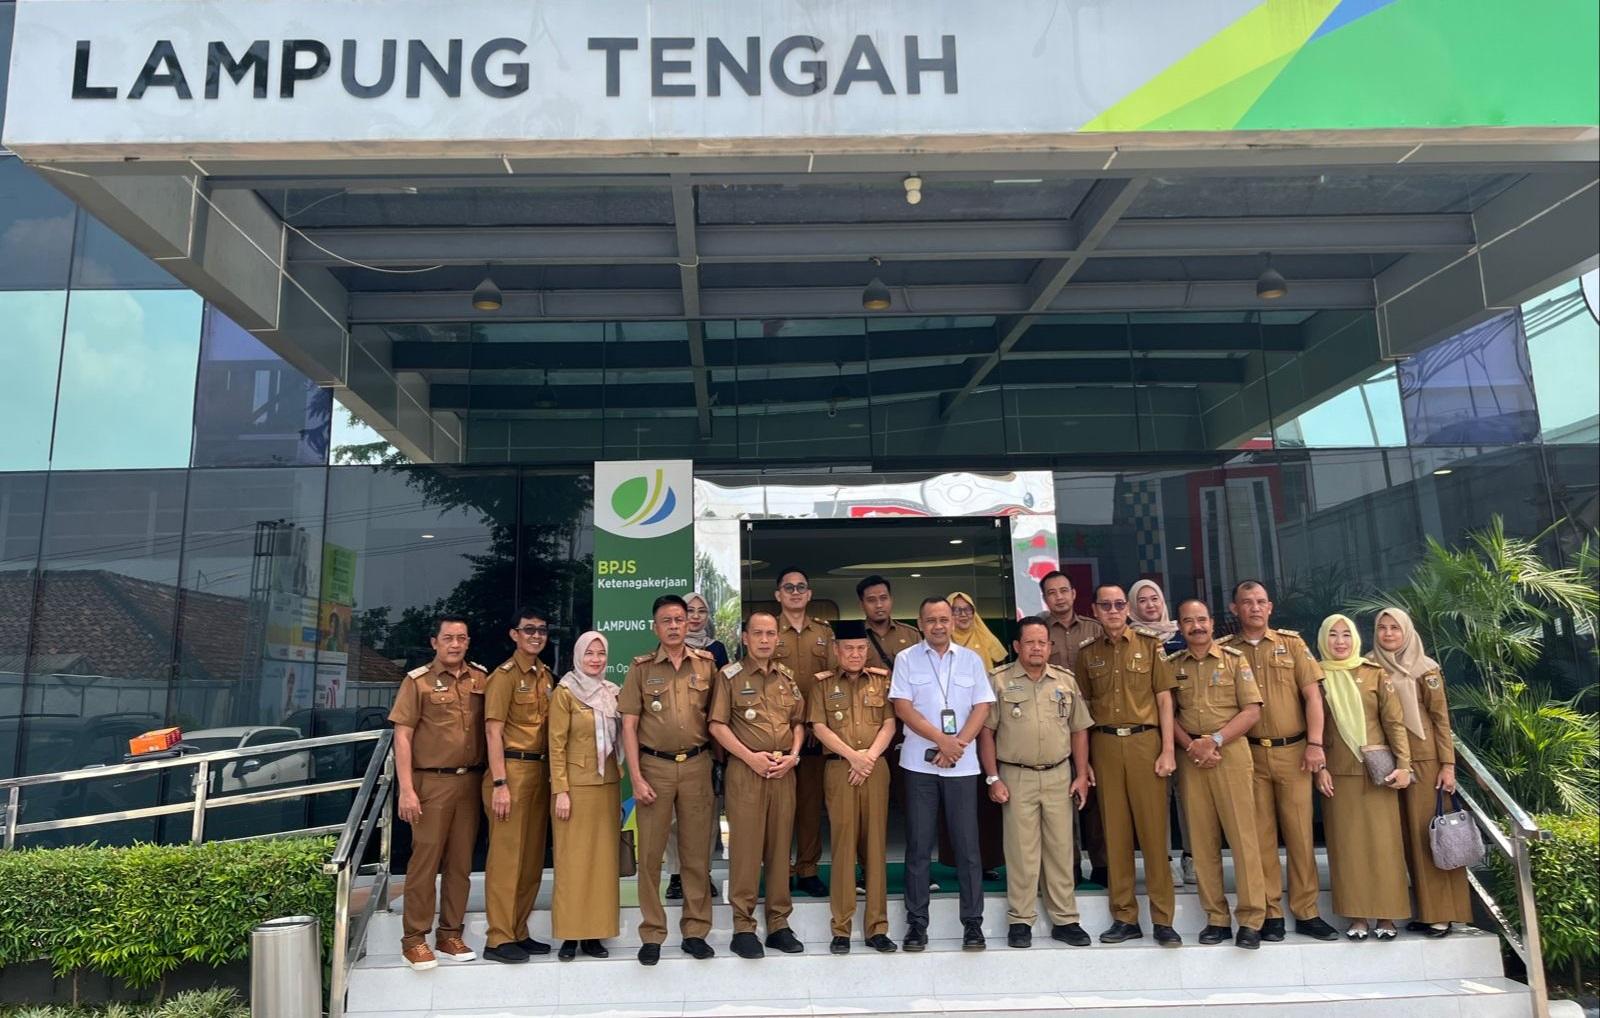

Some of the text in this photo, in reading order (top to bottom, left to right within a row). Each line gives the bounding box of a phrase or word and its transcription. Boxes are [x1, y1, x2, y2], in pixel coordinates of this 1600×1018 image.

[71, 34, 959, 100] LAMPUNG TENGAH
[598, 560, 637, 575] BPJS
[598, 577, 688, 590] Ketenagakerjaan
[597, 619, 655, 632] LAMPUNG T
[616, 663, 629, 674] Op
